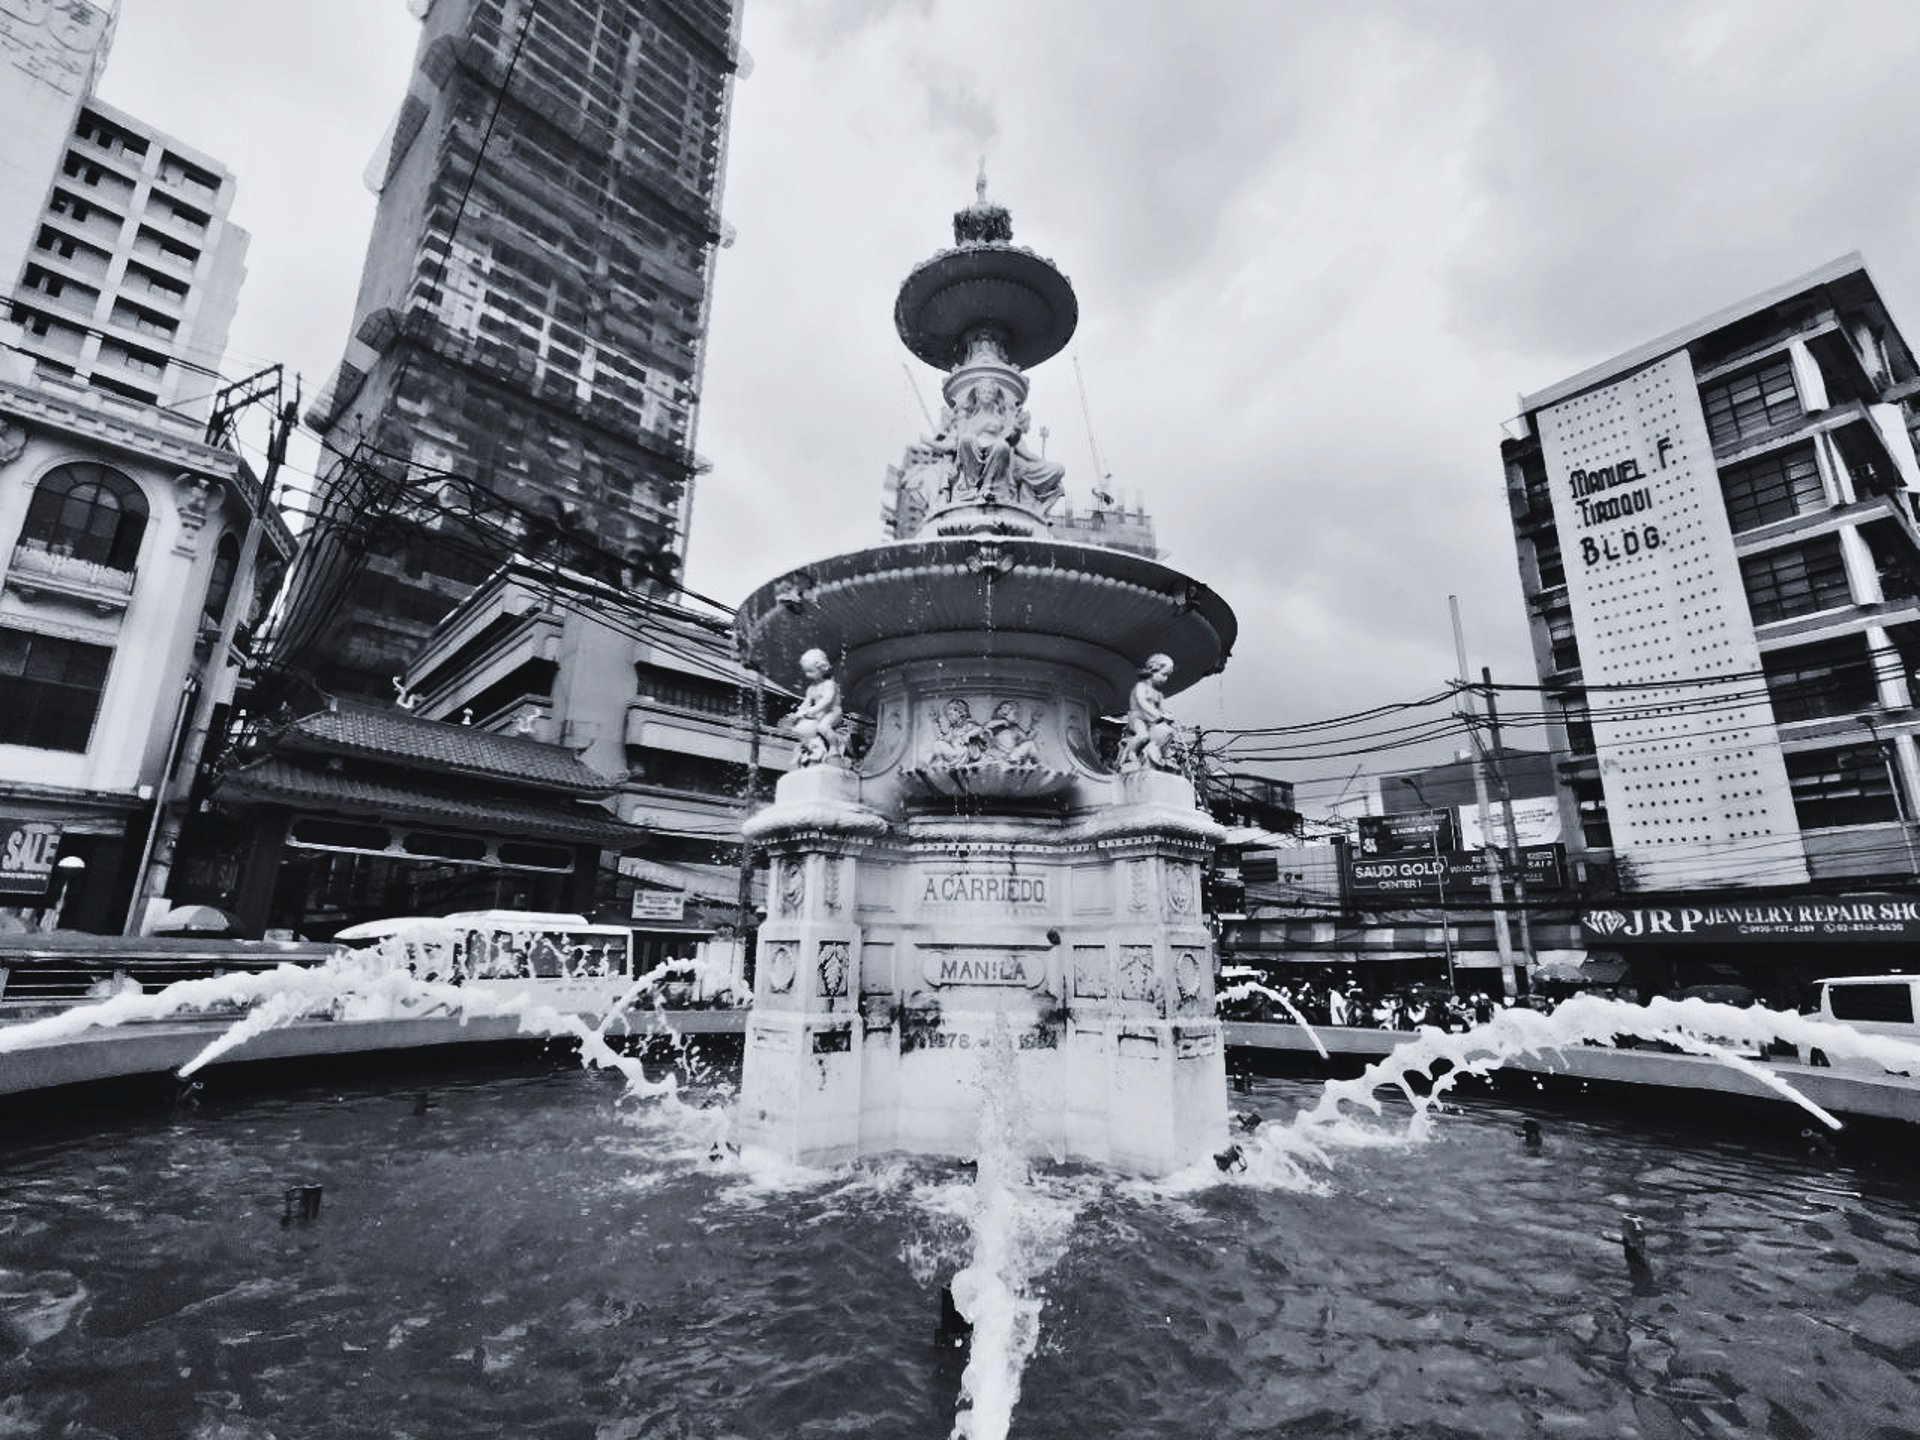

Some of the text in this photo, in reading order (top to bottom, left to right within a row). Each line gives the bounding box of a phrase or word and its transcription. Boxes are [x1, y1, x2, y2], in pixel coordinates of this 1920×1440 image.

[2, 831, 60, 873] SALE
[1355, 862, 1444, 878] SAUDI GOLD
[1378, 880, 1416, 889] CENTER
[1623, 908, 1703, 936] JRP
[1704, 907, 1793, 925] JEWELRY
[1798, 904, 1877, 922] REPAIR
[940, 959, 1026, 981] MANILA
